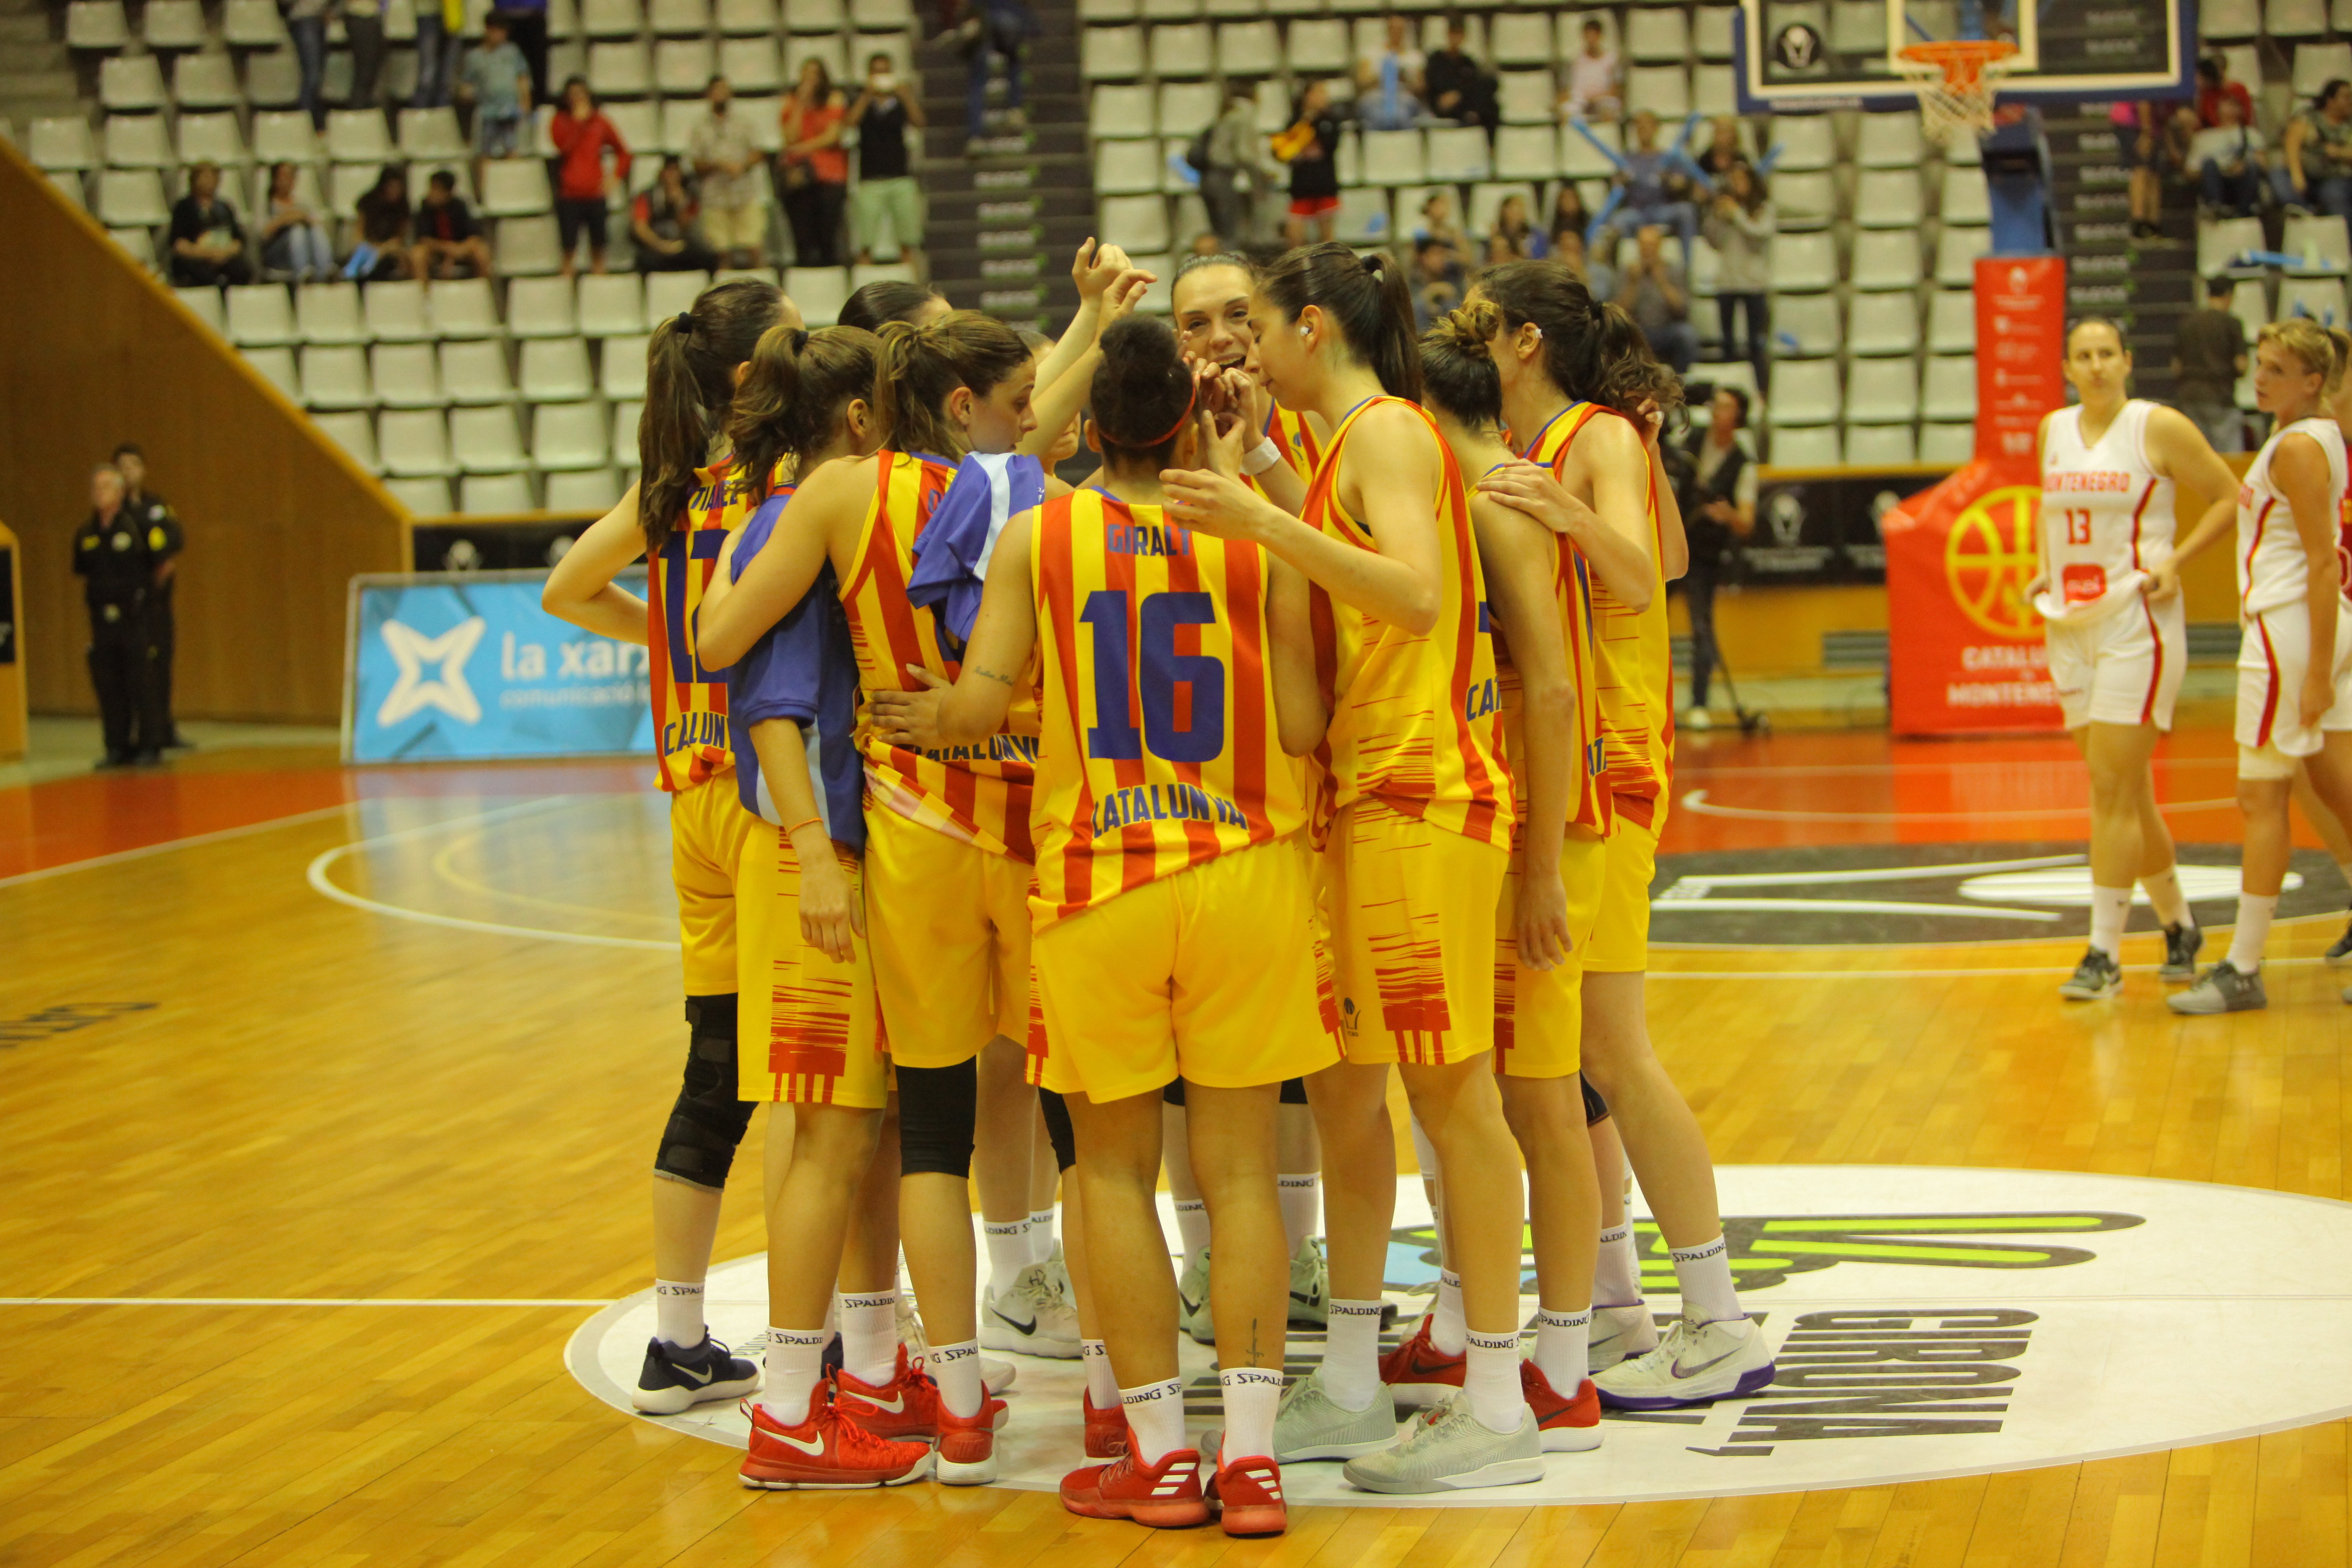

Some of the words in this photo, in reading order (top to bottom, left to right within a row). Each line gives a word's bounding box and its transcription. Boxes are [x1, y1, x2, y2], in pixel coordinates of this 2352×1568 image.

[1108, 524, 1191, 556] GIRALT
[2065, 508, 2090, 544] 13
[502, 631, 546, 681] la
[1079, 590, 1224, 762] 16
